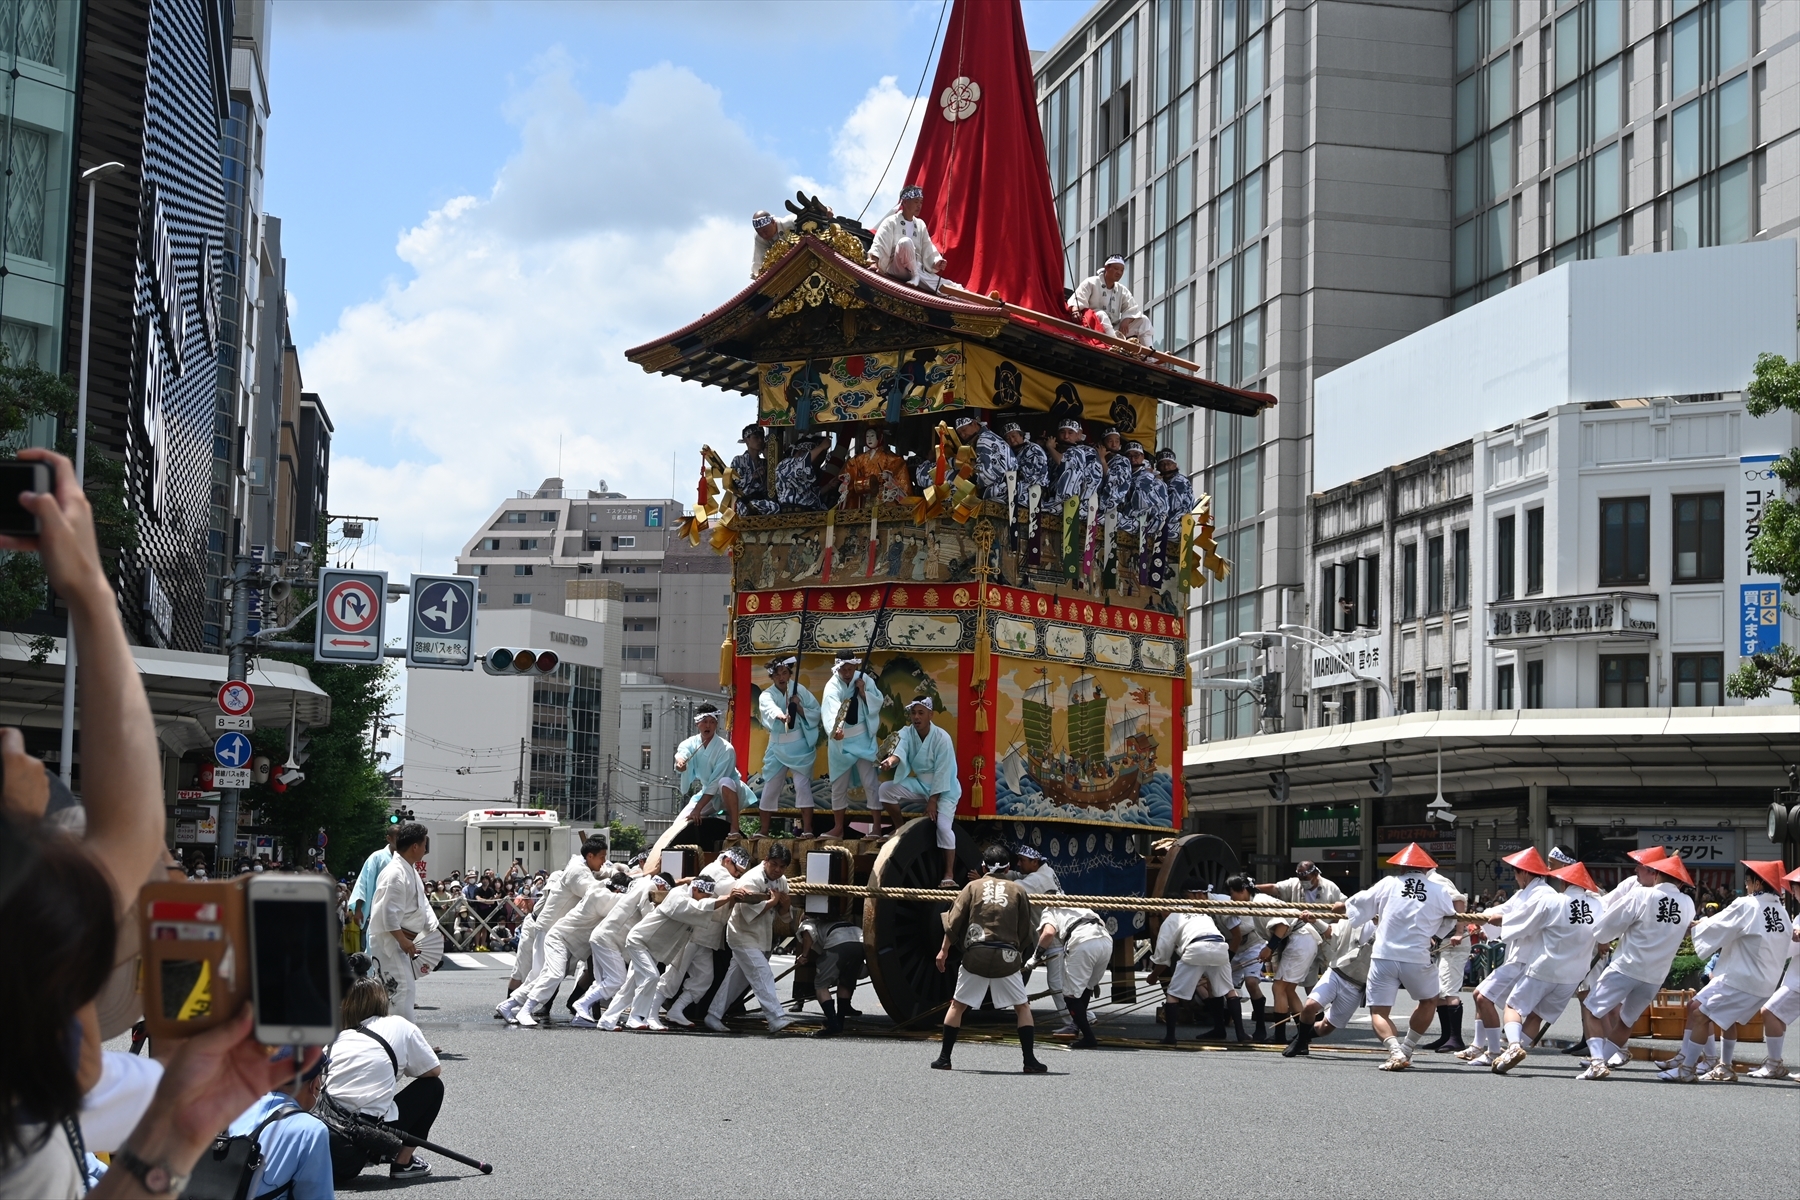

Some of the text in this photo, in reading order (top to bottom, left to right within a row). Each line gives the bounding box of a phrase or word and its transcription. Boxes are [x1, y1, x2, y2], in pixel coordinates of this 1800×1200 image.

[144, 315, 168, 525] EDION
[1761, 591, 1775, 624] すぐ
[1493, 603, 1614, 636] 池善化粧品店
[1744, 590, 1759, 654] 買えます
[415, 641, 467, 656] 路線バスを除く
[569, 634, 588, 647] SEED
[1359, 647, 1379, 670] 雲の茶
[214, 770, 249, 778] 路線バスを除く
[1299, 818, 1339, 839] MARUMARU
[1387, 828, 1439, 839] アクセスチケット
[1674, 834, 1723, 842] メガネスーパー
